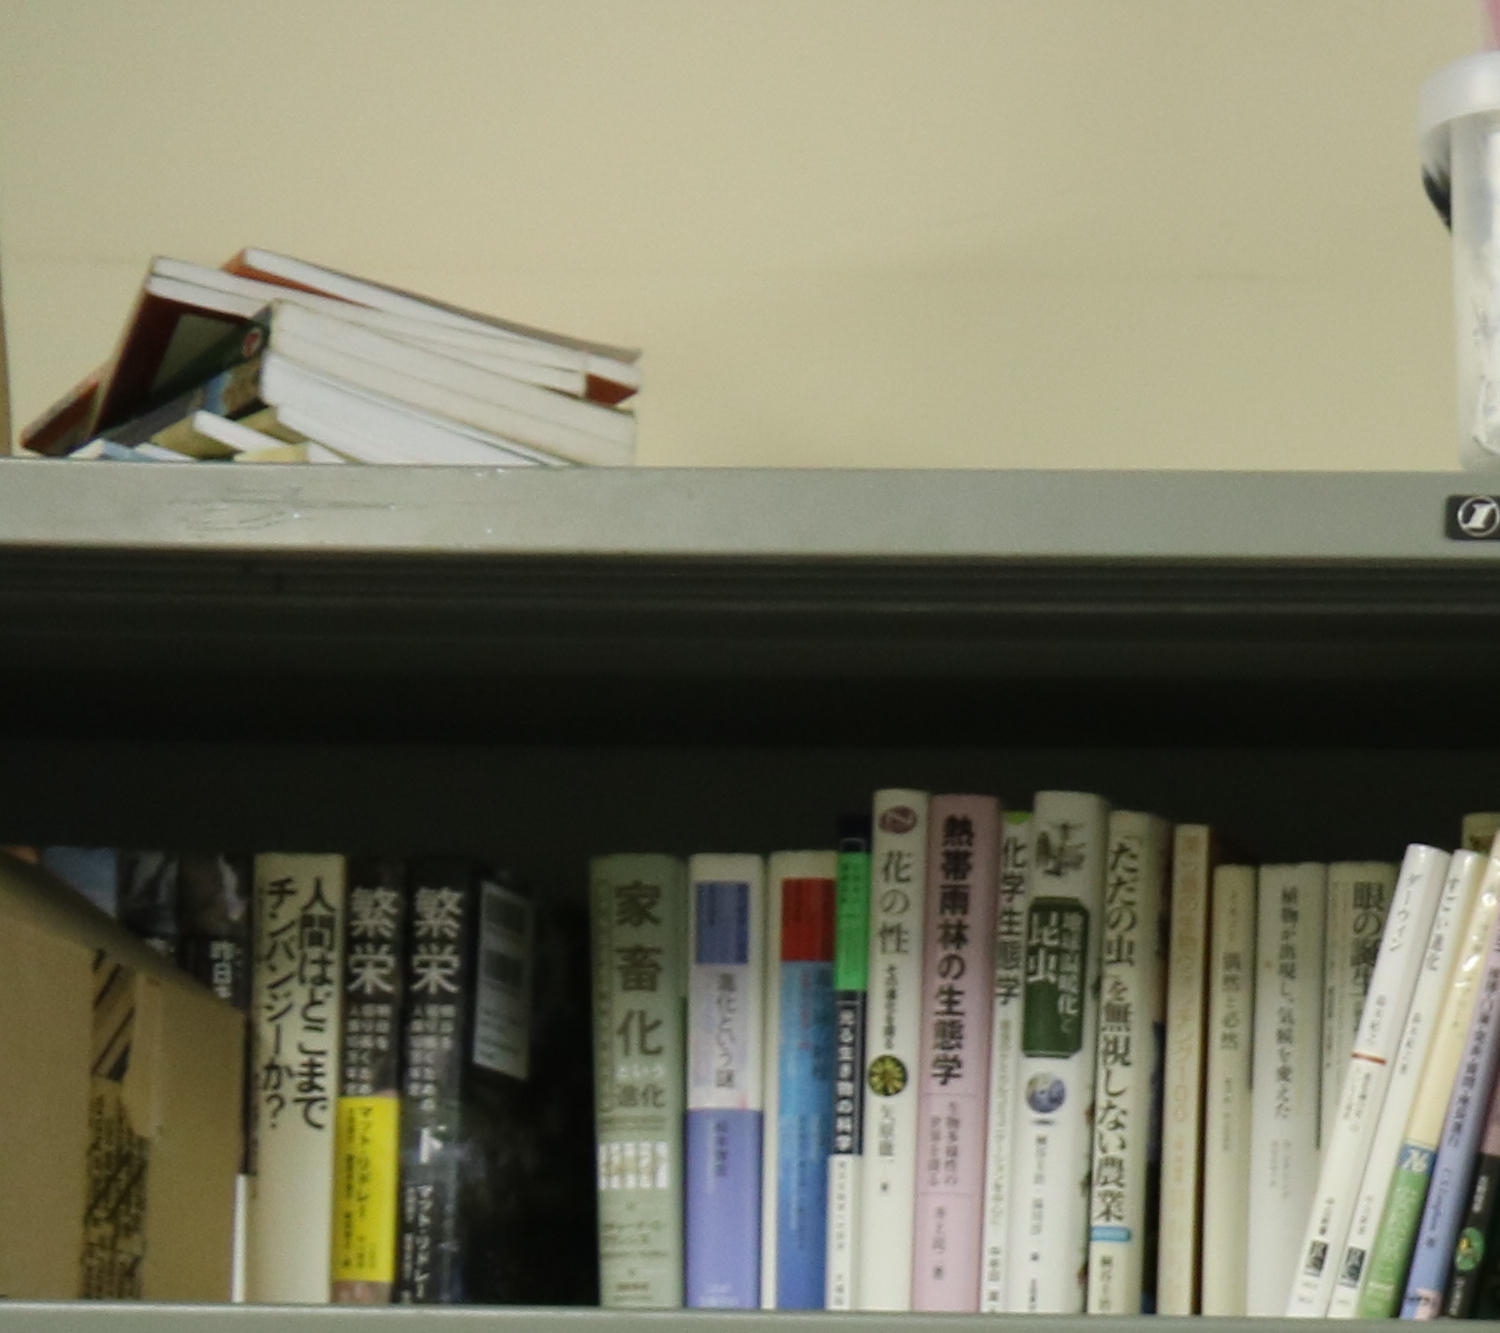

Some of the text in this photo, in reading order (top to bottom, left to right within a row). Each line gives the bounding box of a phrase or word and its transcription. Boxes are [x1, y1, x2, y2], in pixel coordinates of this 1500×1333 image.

[348, 886, 398, 995] 繁栄
[410, 886, 464, 995] 繁栄
[614, 879, 665, 1059] 家畜化
[880, 850, 915, 956] 花の性
[930, 813, 973, 1086] 熱帯雨林の生態学
[994, 836, 1029, 1006] 化学生態学
[1026, 906, 1060, 985] 昆虫
[296, 877, 336, 1130] 人間はどこまで
